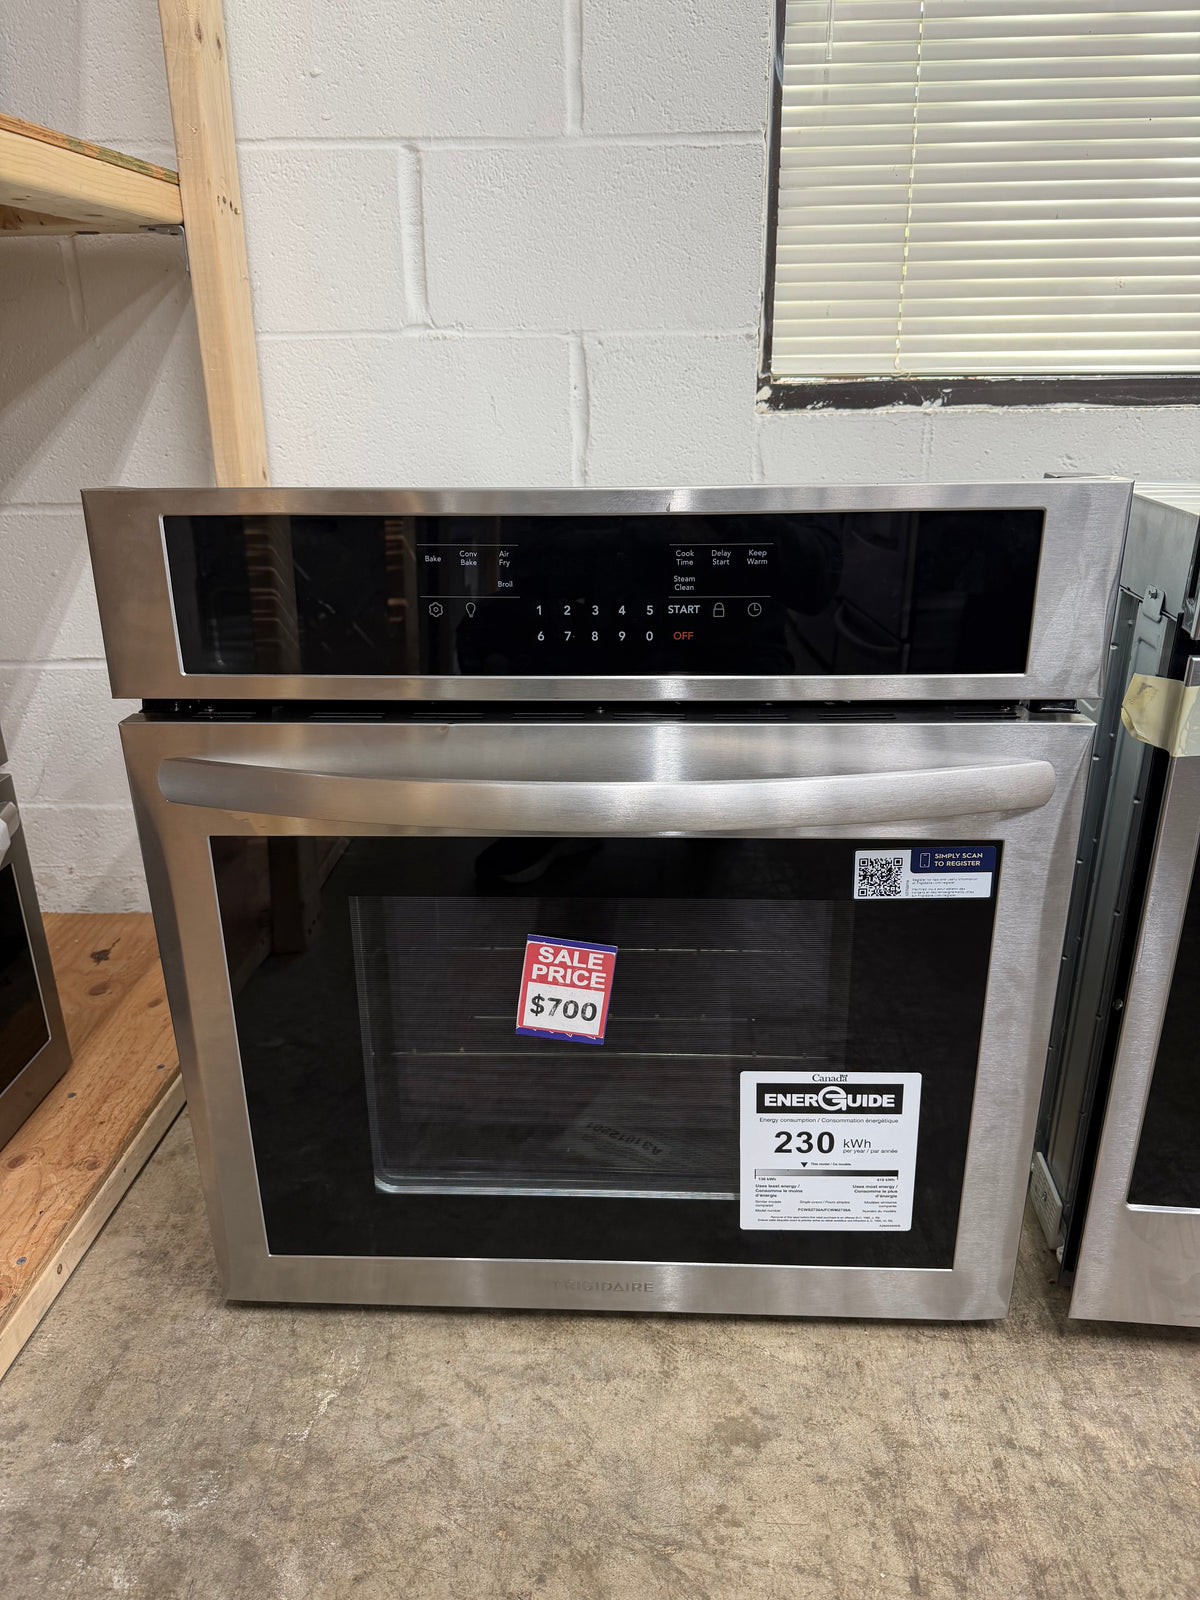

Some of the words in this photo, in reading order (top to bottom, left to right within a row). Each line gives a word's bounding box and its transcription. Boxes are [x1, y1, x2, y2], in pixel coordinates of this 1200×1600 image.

[459, 550, 478, 558] Conv
[499, 550, 510, 558] Air
[675, 549, 694, 557] Cook
[711, 549, 732, 558] Delay
[748, 549, 767, 558] Keep
[499, 559, 510, 568] Fry
[676, 558, 694, 566] Time
[712, 558, 730, 566] Start
[536, 605, 542, 615] 1
[564, 605, 571, 615] 2
[592, 605, 599, 615] 3
[618, 605, 626, 615] 4
[646, 605, 654, 615] 5
[668, 605, 700, 614] START
[537, 631, 545, 641] 6
[564, 631, 572, 641] 7
[591, 631, 599, 641] 8
[618, 631, 626, 641] 9
[646, 631, 654, 641] 0
[673, 631, 694, 640] OFF
[538, 946, 604, 970] SALE
[531, 963, 607, 989] PRICE
[530, 994, 597, 1022] $700
[812, 1074, 848, 1082] Canada
[764, 1085, 895, 1111] ENERGUIDE
[774, 1131, 835, 1154] 230
[843, 1139, 872, 1148] kWh
